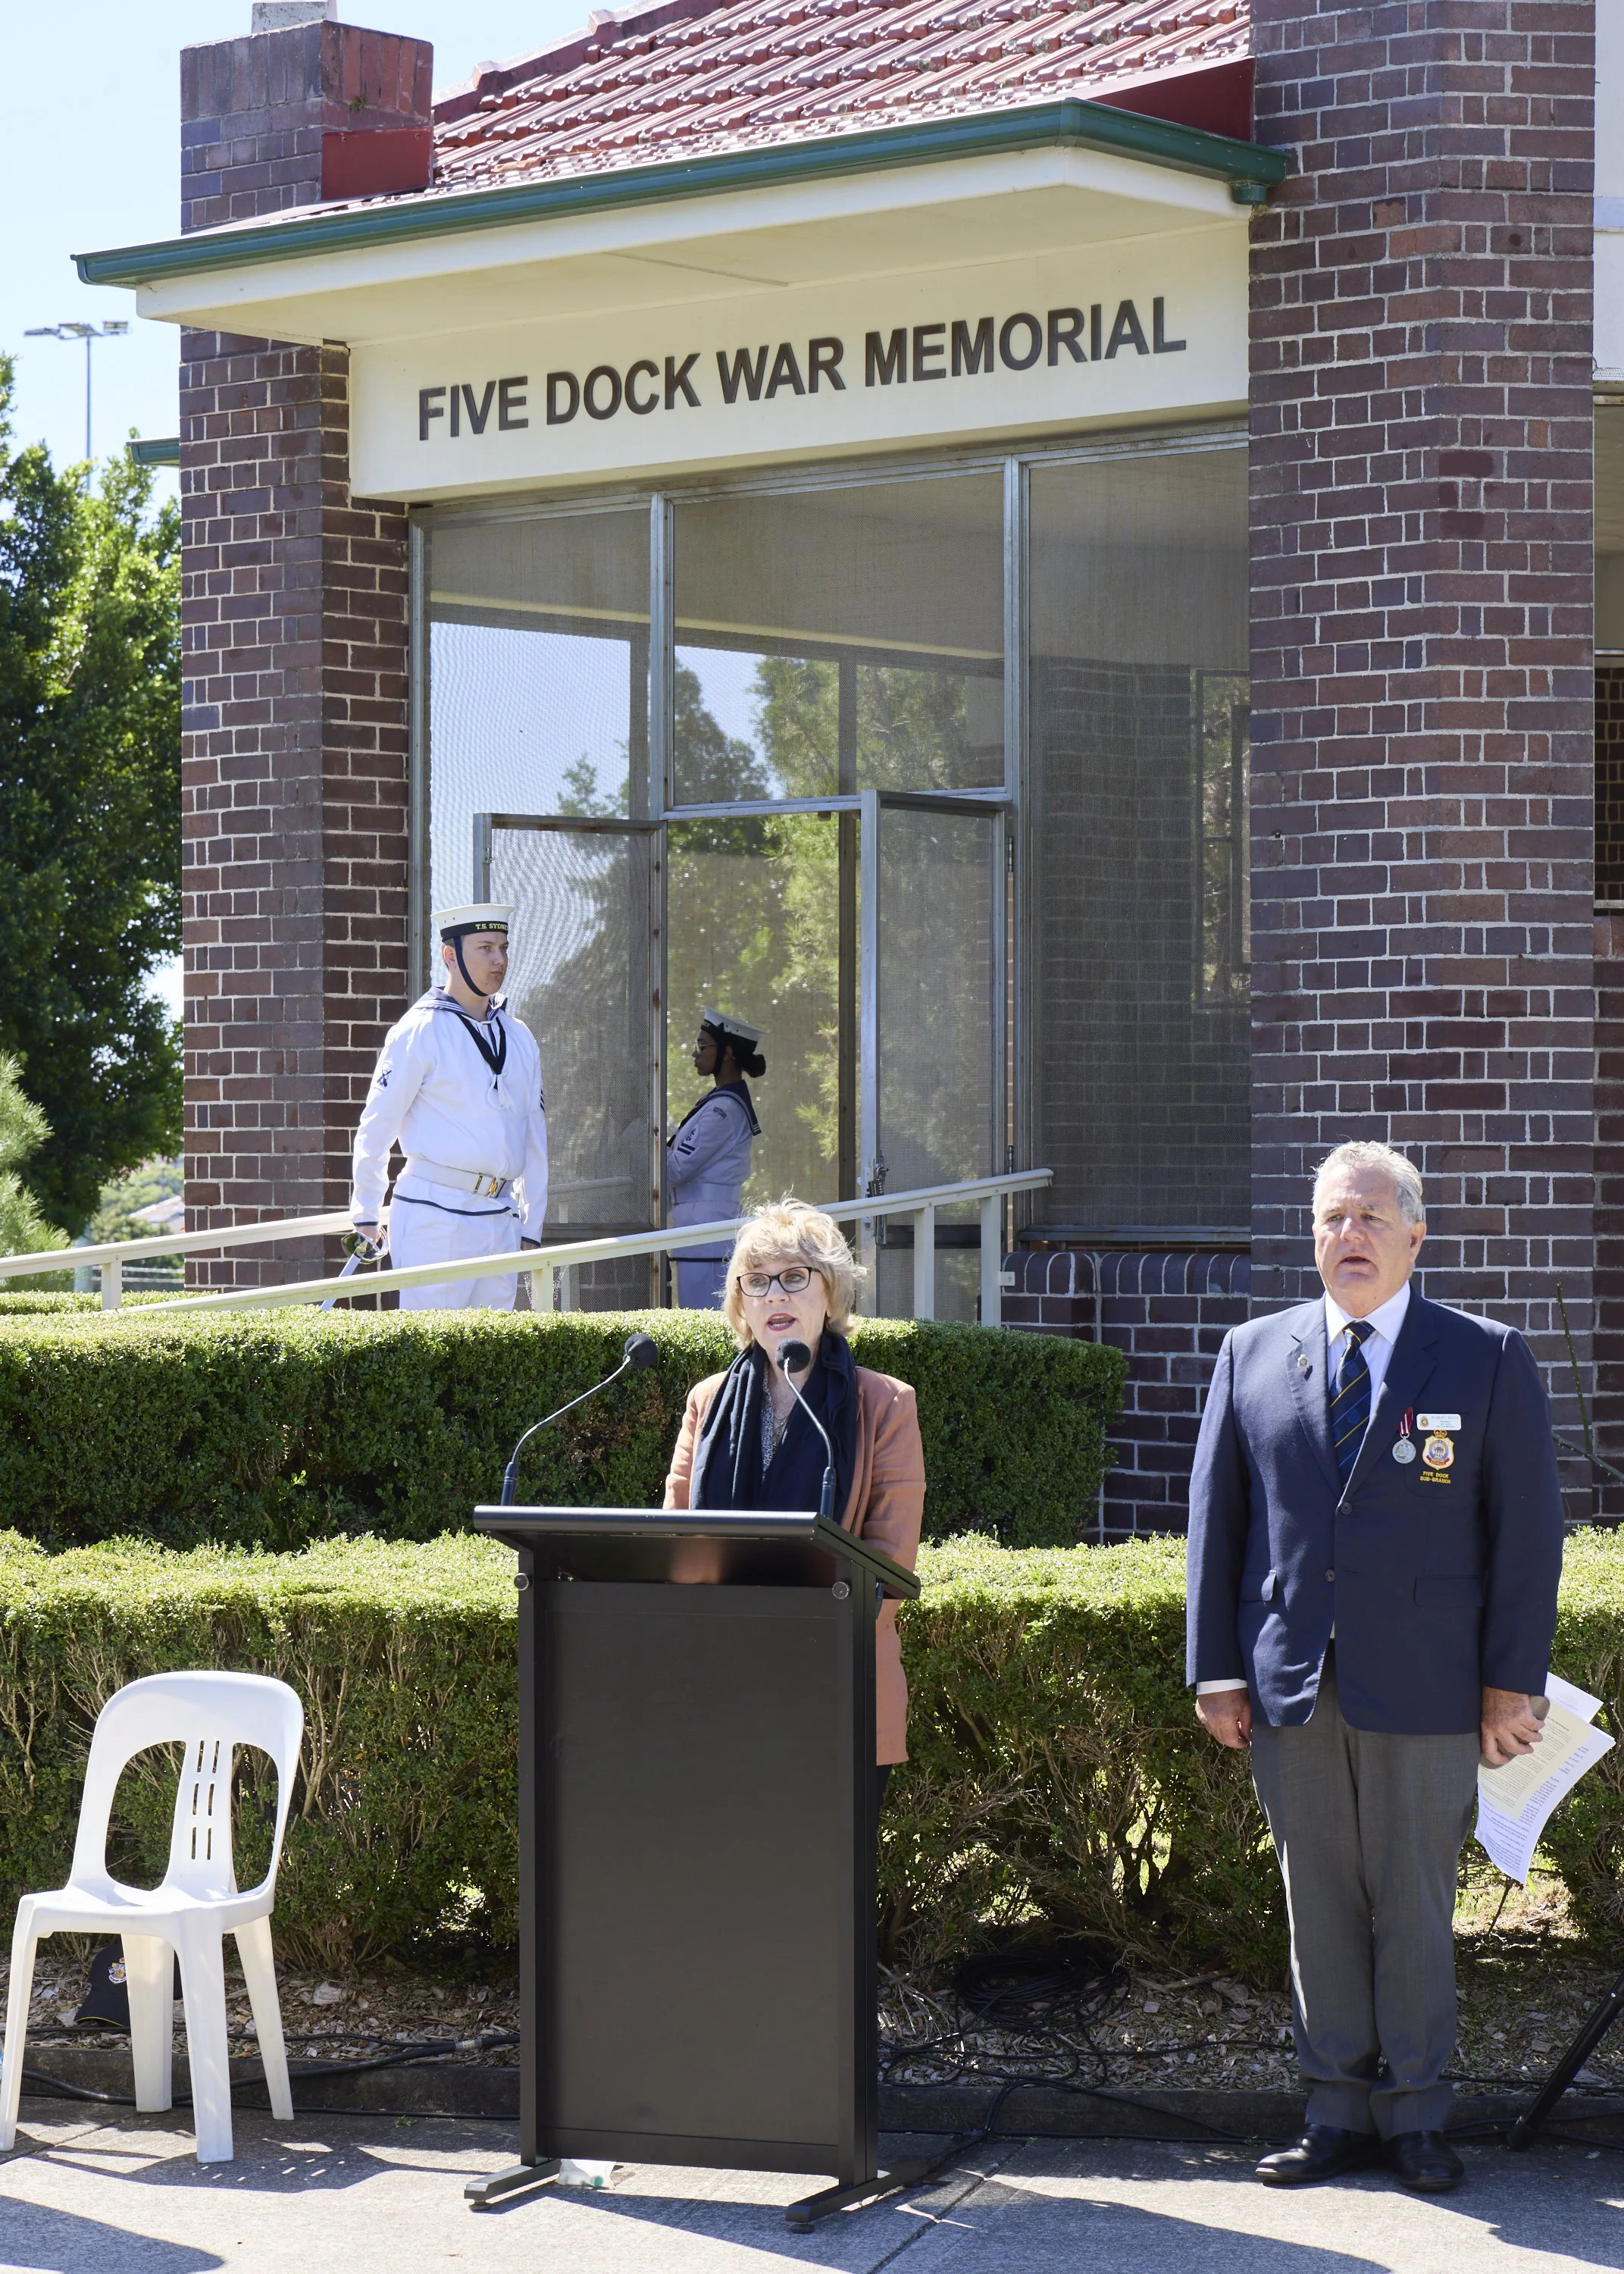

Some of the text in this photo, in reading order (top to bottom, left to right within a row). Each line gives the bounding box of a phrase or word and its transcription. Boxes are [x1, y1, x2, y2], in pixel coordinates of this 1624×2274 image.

[418, 296, 1187, 441] FIVE DOCK WAR MEMORIAL
[1419, 1476, 1451, 1484] SUB-BRANCH
